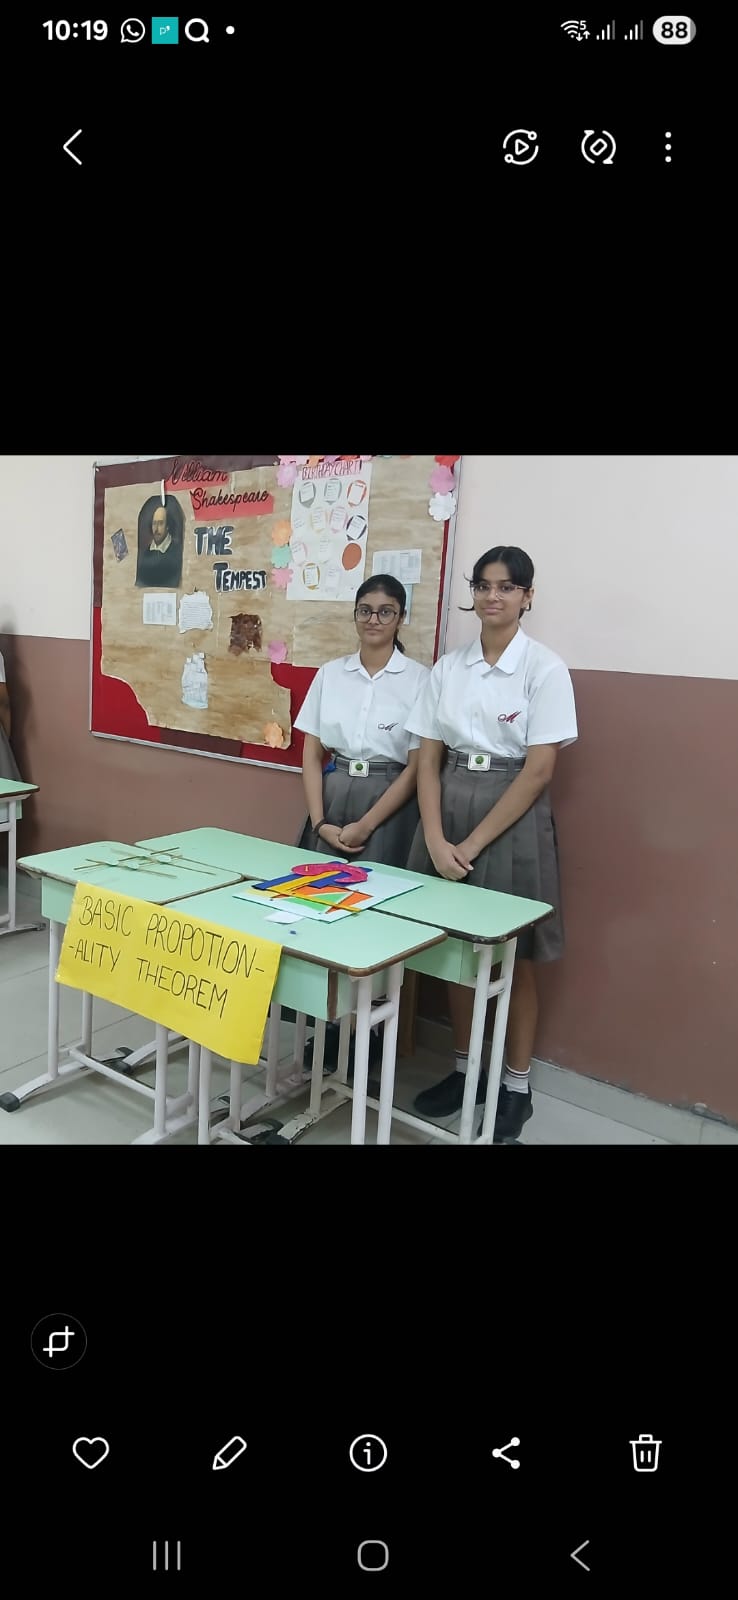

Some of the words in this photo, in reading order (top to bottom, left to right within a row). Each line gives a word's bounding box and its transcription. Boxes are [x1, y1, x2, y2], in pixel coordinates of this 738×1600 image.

[169, 459, 228, 485] William
[189, 487, 269, 513] Shakespeare
[194, 525, 234, 556] THE
[213, 561, 267, 593] TEMPEST
[78, 895, 134, 937] BASIC
[145, 913, 265, 979] PROPOTION-
[68, 938, 121, 973] -ALITY
[136, 957, 229, 1019] THEOREM
